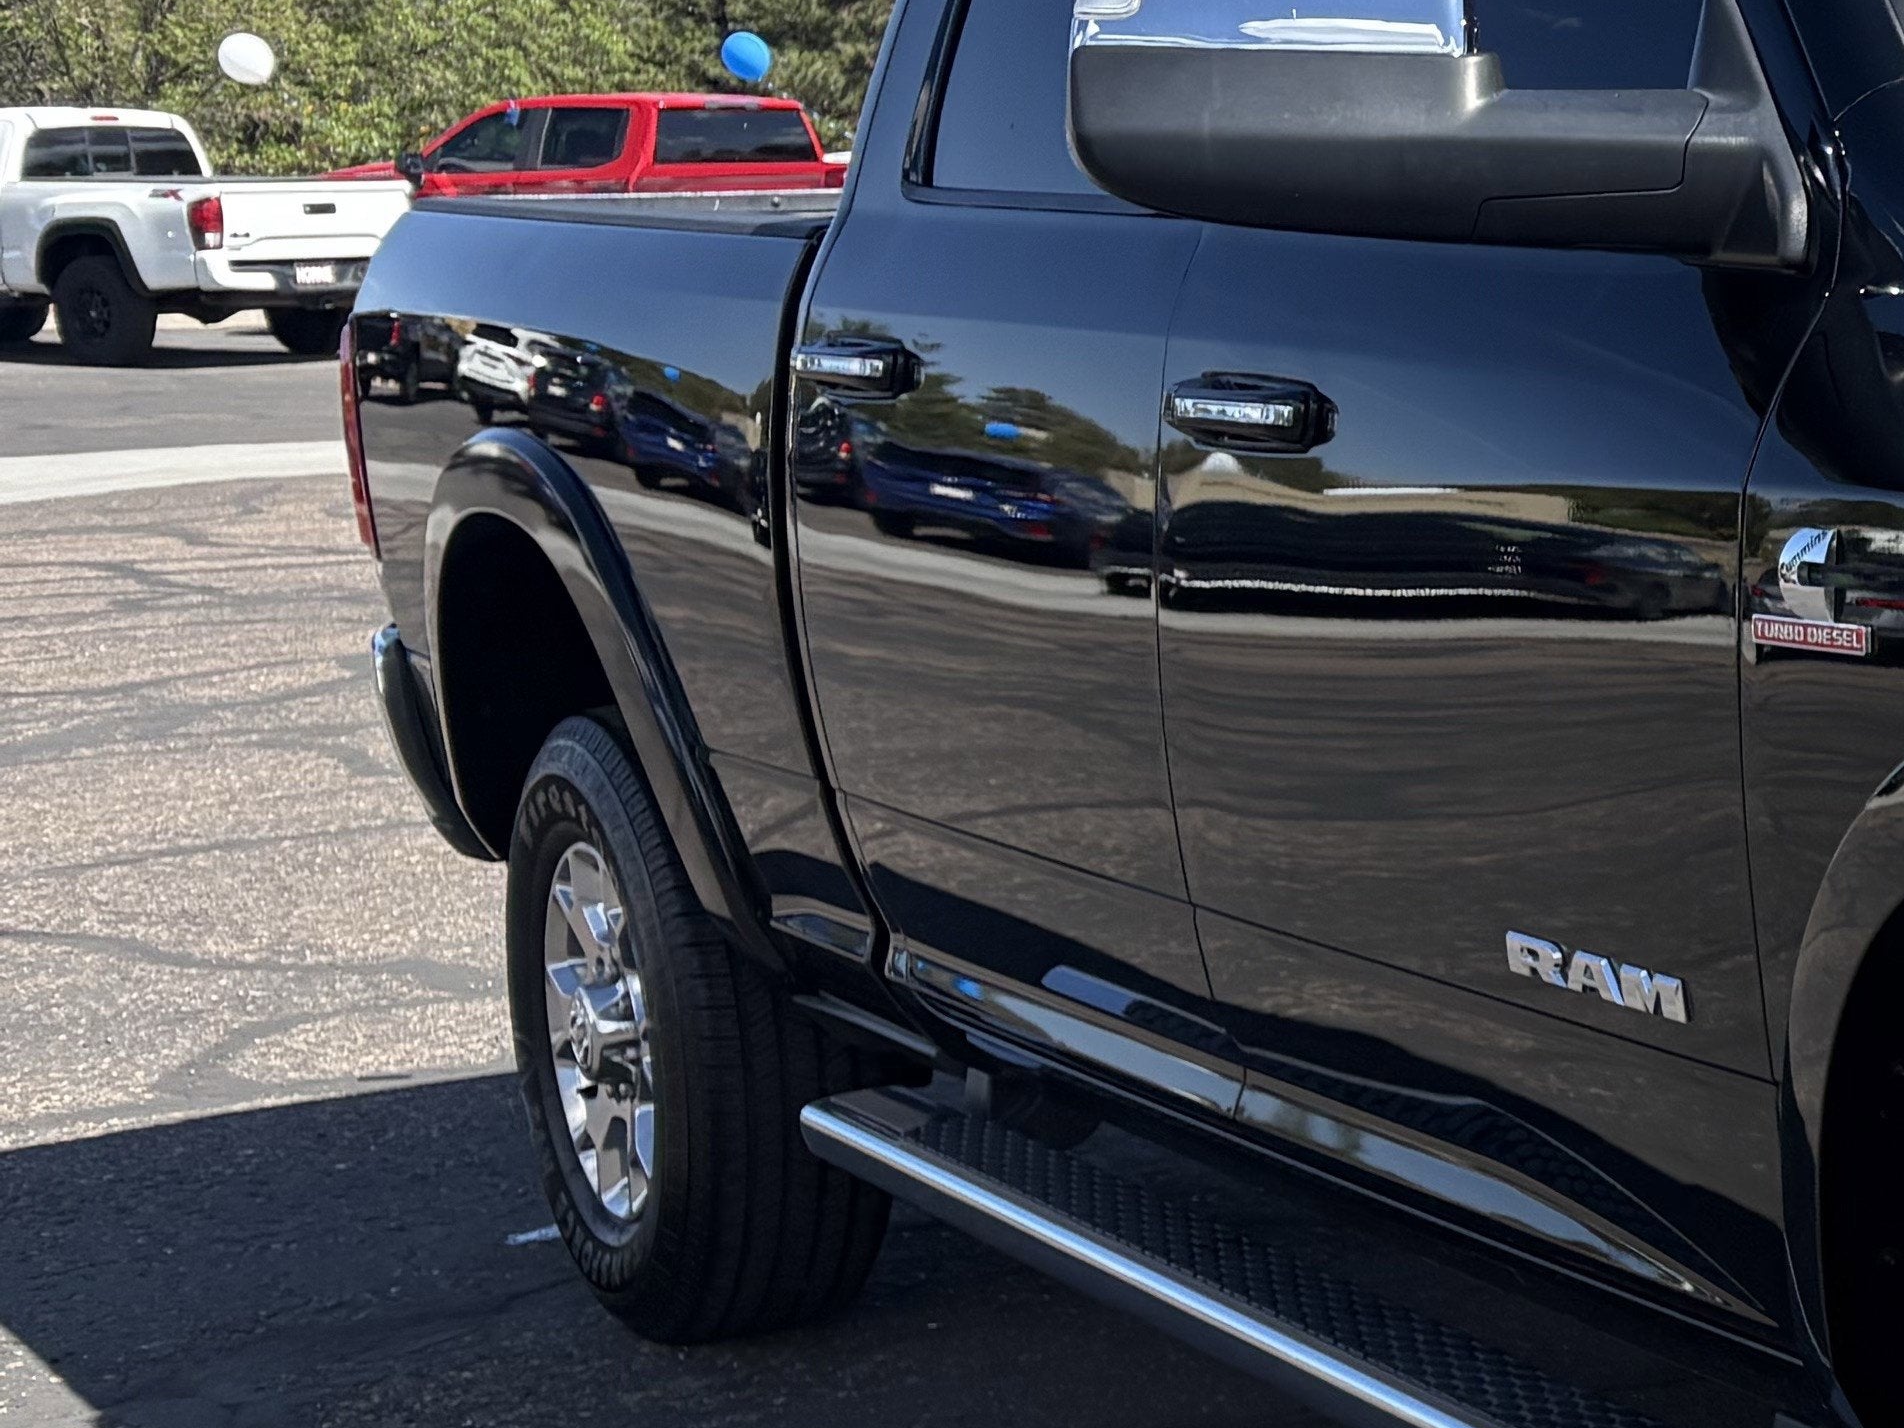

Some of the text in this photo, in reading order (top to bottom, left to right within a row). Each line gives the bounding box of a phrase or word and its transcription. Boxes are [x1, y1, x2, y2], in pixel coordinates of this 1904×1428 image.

[1780, 530, 1829, 585] Cummins
[1756, 622, 1862, 648] TURBO DIESEL
[1505, 929, 1690, 1024] RAM
